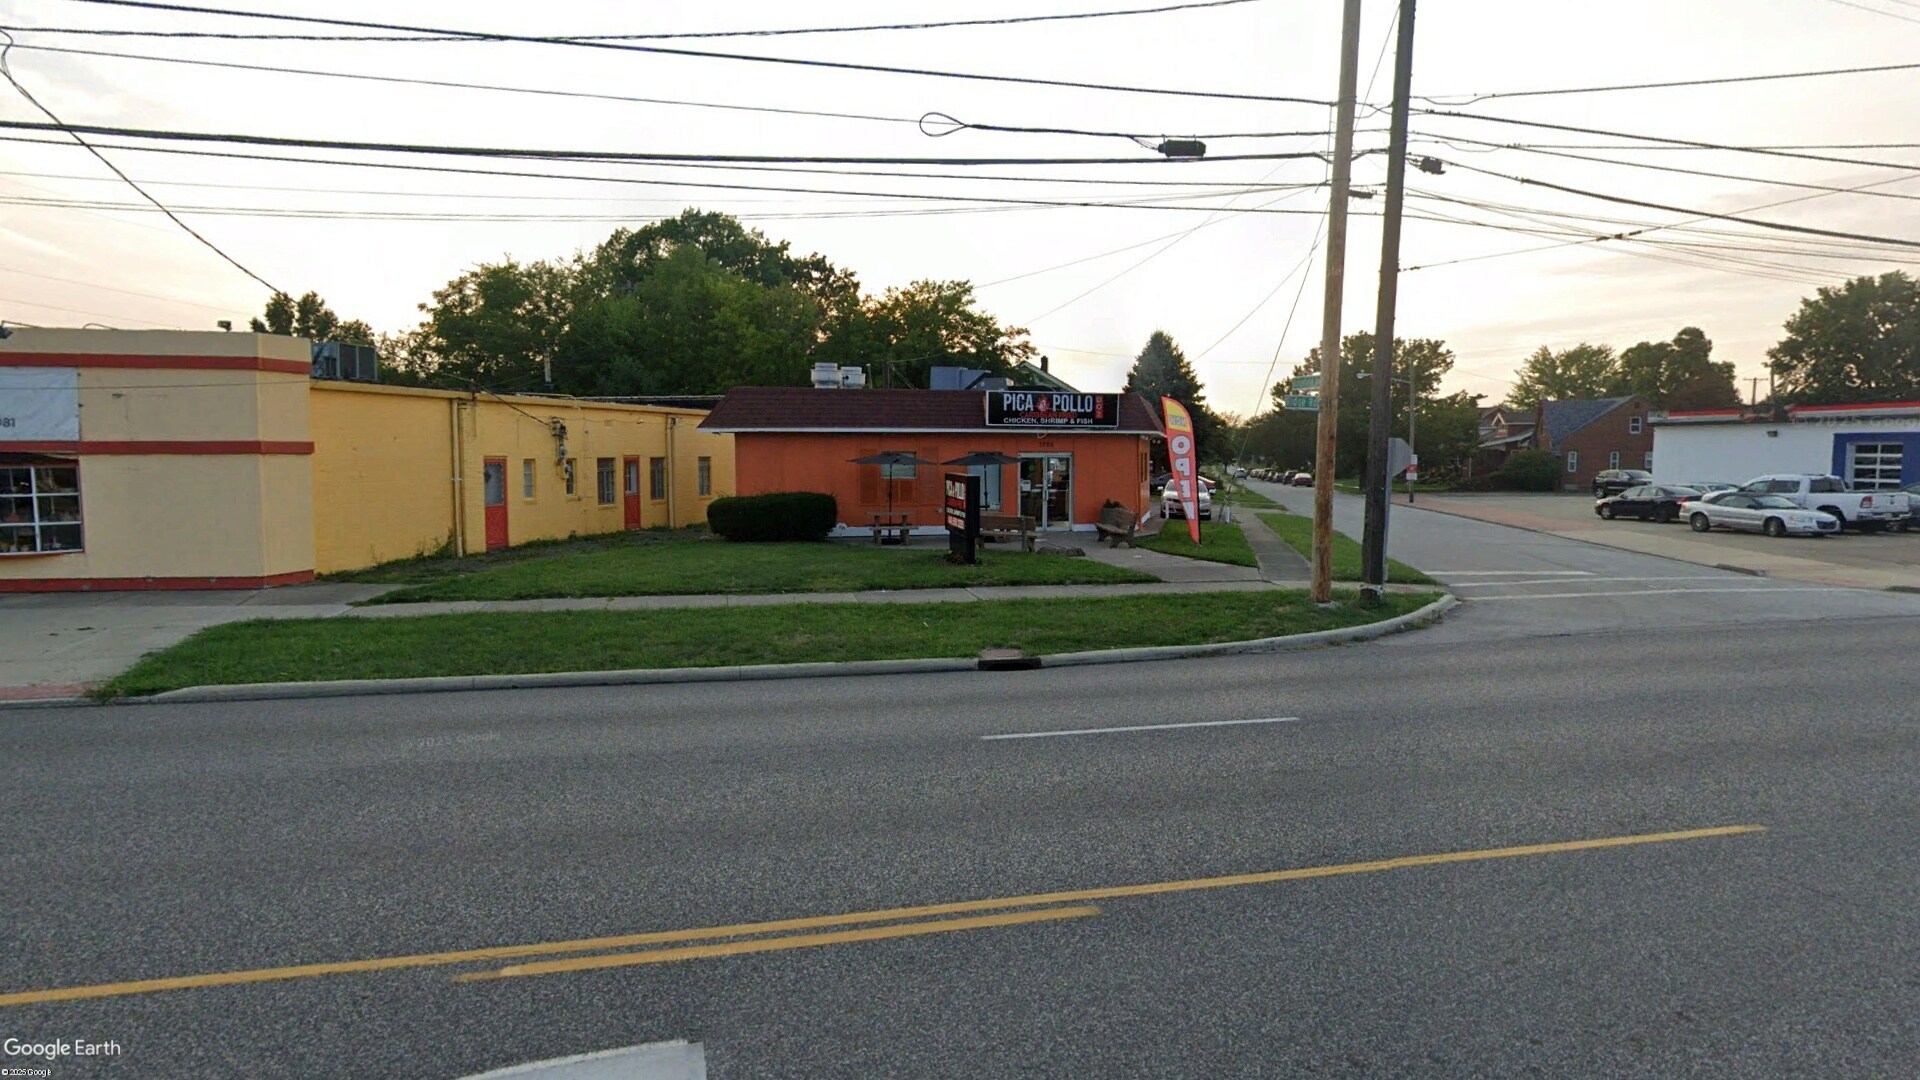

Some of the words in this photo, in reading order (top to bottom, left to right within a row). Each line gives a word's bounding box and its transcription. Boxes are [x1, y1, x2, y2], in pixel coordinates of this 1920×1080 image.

[1003, 393, 1035, 412] PICA
[1052, 394, 1093, 413] POLLO
[1003, 417, 1039, 425] CHICKEN,
[1041, 417, 1069, 425] SHRIMP
